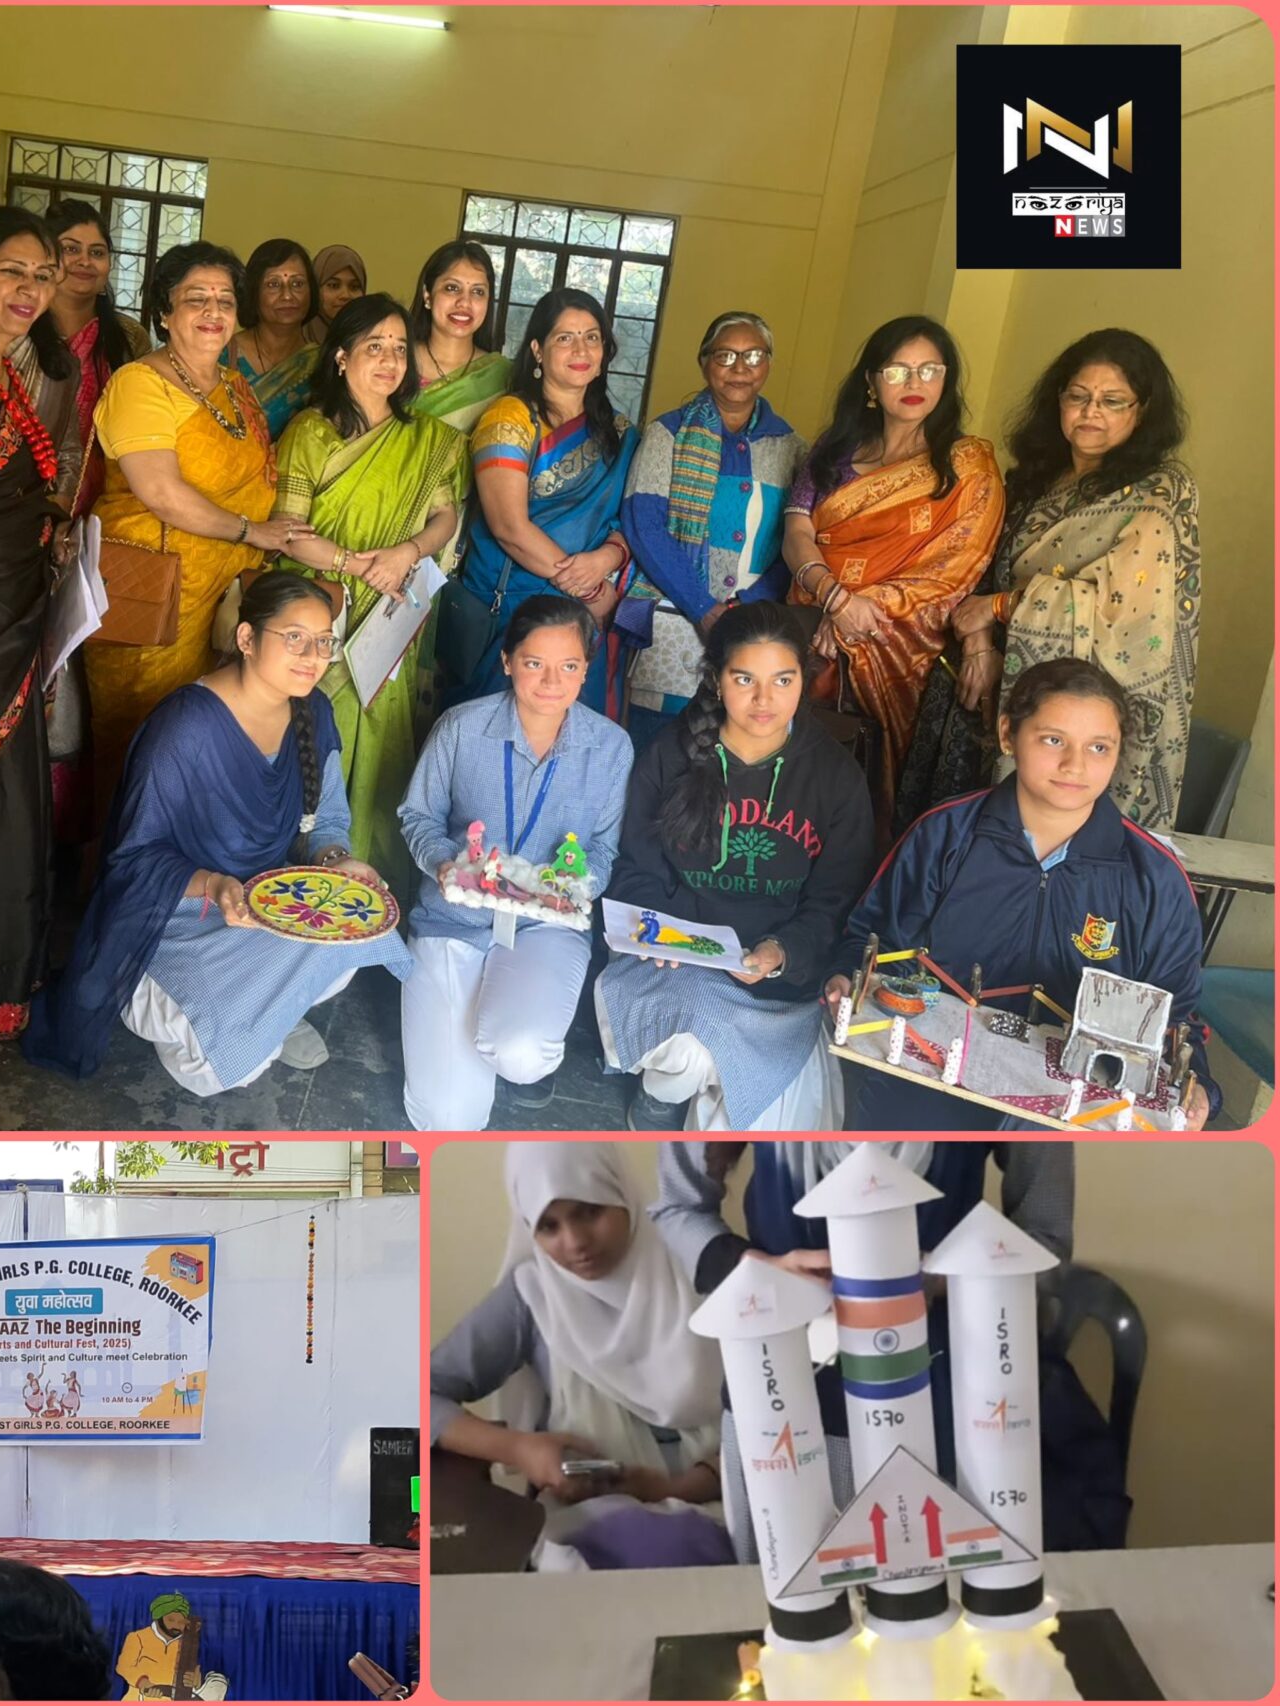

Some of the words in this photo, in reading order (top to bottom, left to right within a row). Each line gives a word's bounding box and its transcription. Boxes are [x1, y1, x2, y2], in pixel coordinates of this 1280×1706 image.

[681, 870, 758, 893] XPLORE
[15, 1295, 38, 1314] युवा
[42, 1289, 93, 1310] महोत्सव
[34, 1260, 63, 1274] P.G.
[68, 1260, 134, 1288] COLLEGE,
[138, 1276, 203, 1325] ROORKEE
[35, 1319, 61, 1335] The
[66, 1318, 141, 1337] Beginning
[14, 1340, 32, 1349] and
[34, 1338, 73, 1349] Cultural
[76, 1338, 100, 1350] Fest,
[102, 1338, 131, 1349] 2025)
[996, 1307, 1013, 1375] ISRO
[20, 1354, 46, 1364] Spirit
[48, 1353, 66, 1361] and
[68, 1353, 103, 1361] Culture
[106, 1353, 129, 1361] meet
[132, 1352, 188, 1361] Celebration
[762, 1343, 785, 1411] ISRO
[13, 1420, 43, 1430] GIRLS
[46, 1421, 63, 1429] P.G.
[66, 1420, 117, 1430] COLLEGE,
[119, 1420, 170, 1429] ROORKEE
